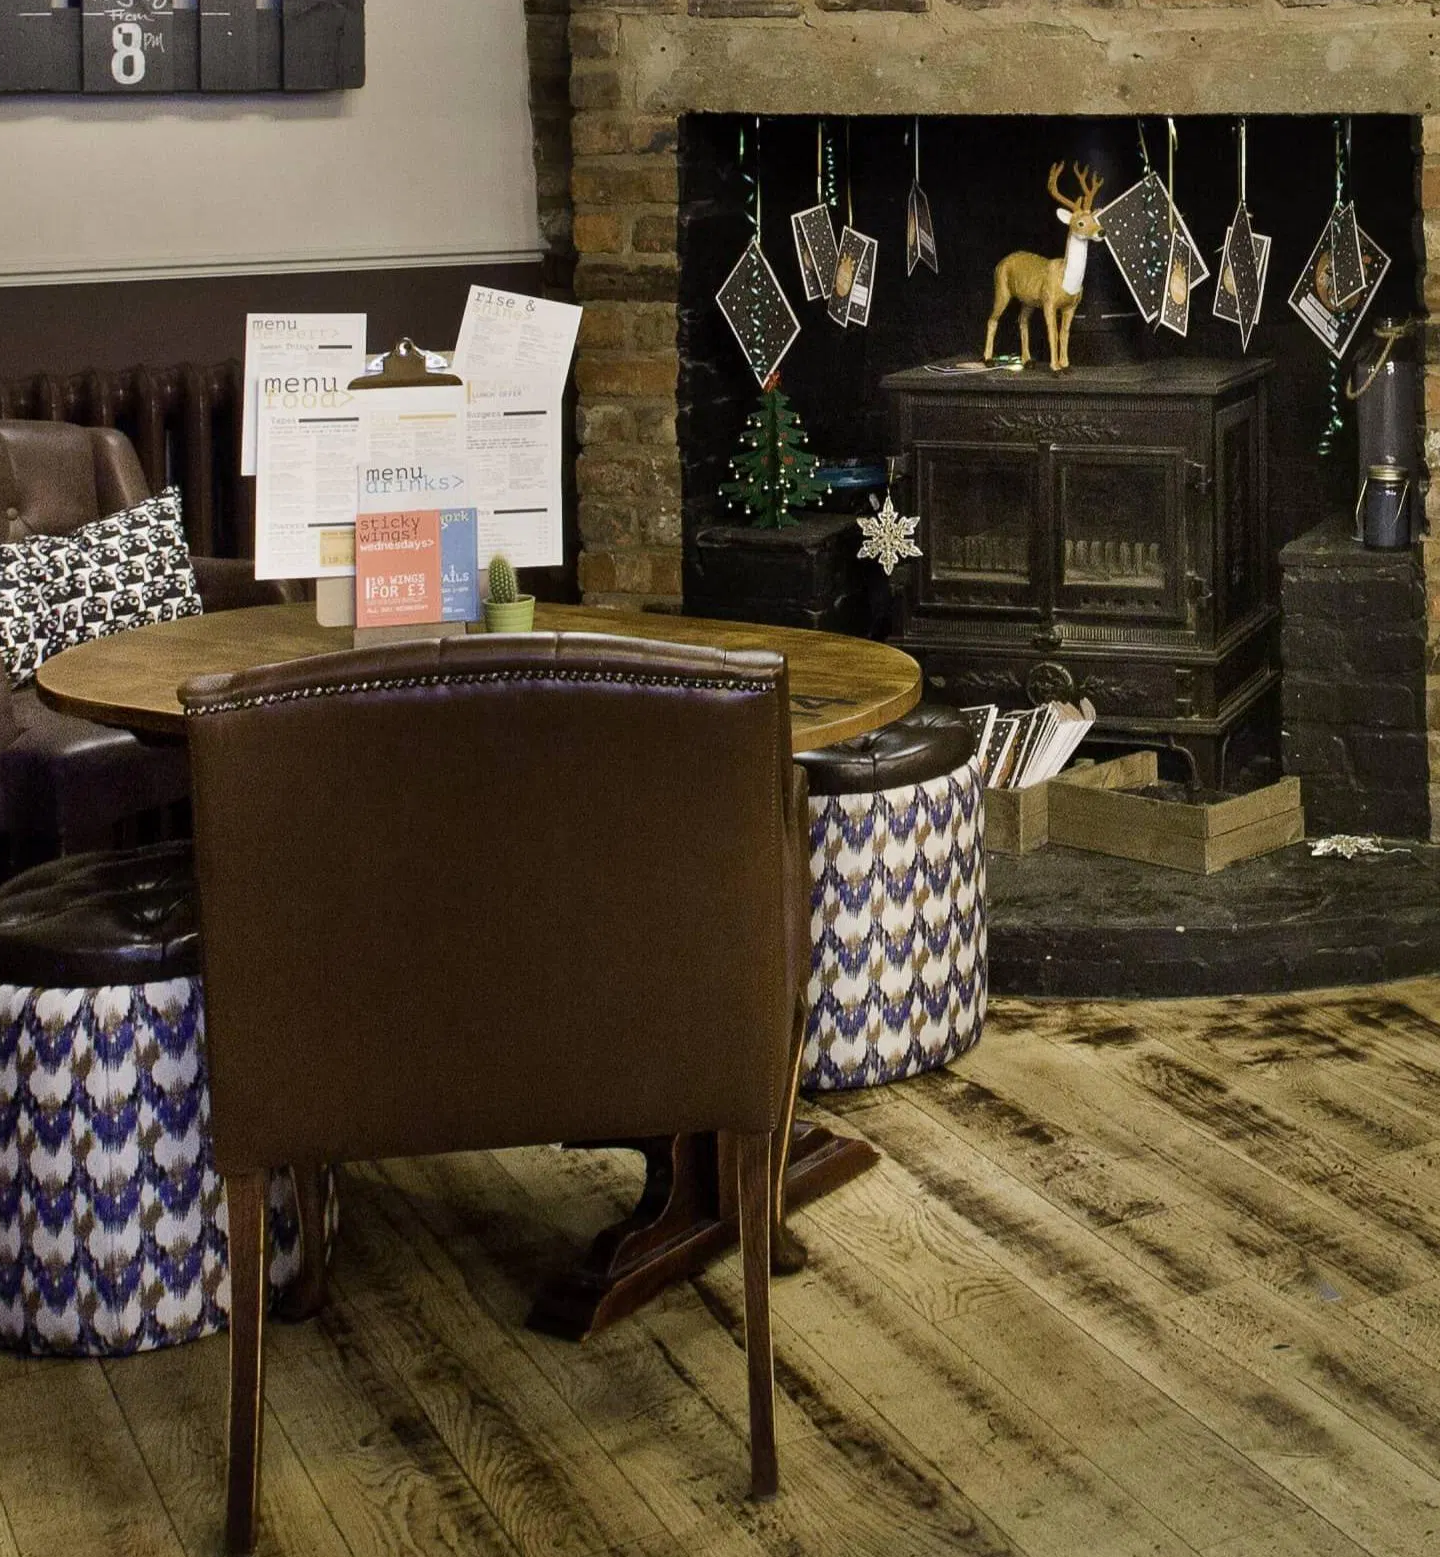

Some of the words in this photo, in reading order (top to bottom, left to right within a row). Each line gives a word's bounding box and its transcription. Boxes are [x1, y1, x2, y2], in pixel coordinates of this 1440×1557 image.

[476, 291, 516, 309] rise
[525, 299, 536, 312] &
[252, 319, 297, 331] menu
[264, 376, 338, 393] menu
[264, 386, 355, 409] food>
[366, 465, 423, 481] menu
[366, 473, 465, 494] drinks>
[361, 514, 420, 531] sticky
[360, 528, 418, 543] wings!
[360, 539, 434, 551] wednesdays>
[371, 576, 385, 586] 10
[390, 573, 426, 586] WINGS
[371, 585, 400, 599] FOR
[407, 583, 426, 597] £3
